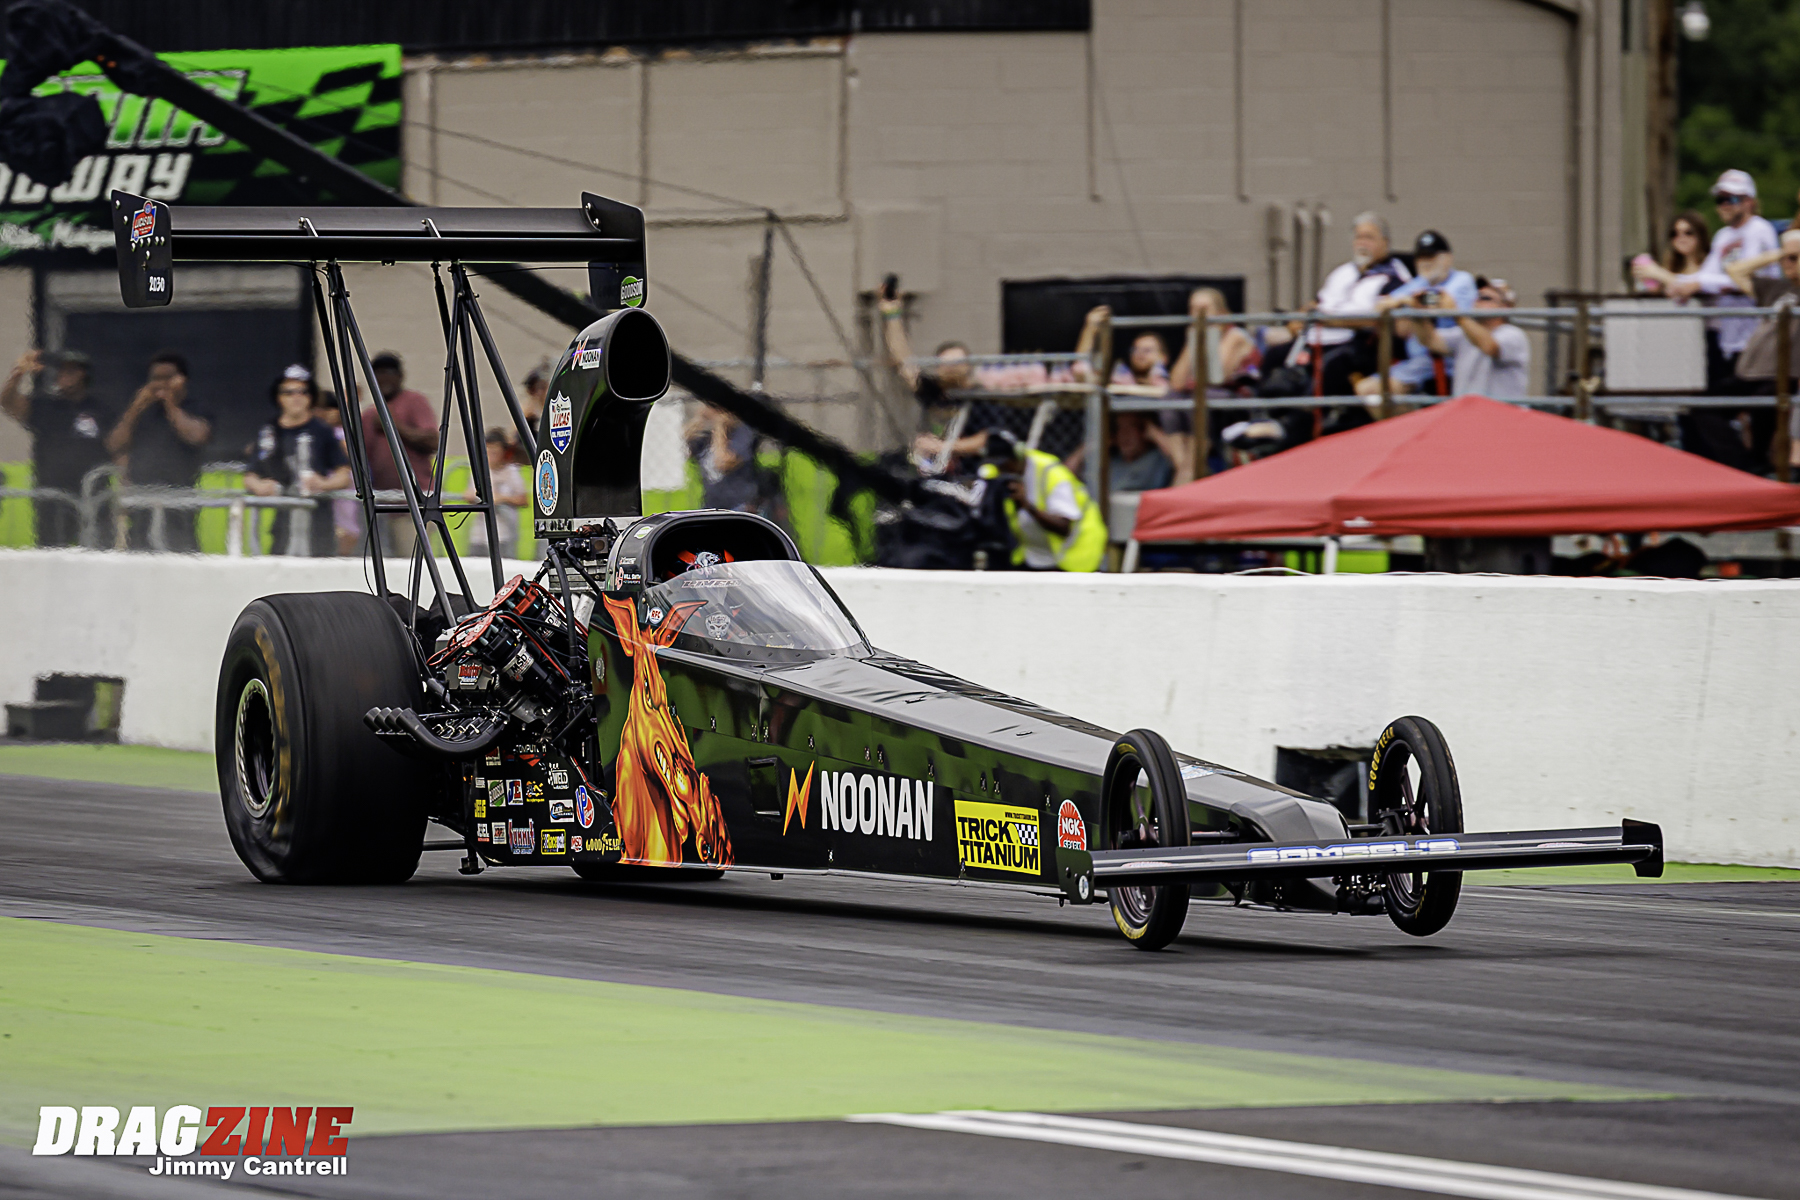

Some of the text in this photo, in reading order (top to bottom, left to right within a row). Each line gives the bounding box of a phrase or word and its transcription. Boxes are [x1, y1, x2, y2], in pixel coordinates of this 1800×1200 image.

[621, 281, 643, 301] GOODSON
[582, 350, 600, 363] NOONAN
[552, 412, 571, 427] LUCAS
[651, 609, 661, 617] RFC
[511, 651, 529, 675] MSD
[1368, 726, 1395, 791] GOODYEAR
[553, 772, 568, 785] WELD
[821, 770, 934, 841] NOONAN
[508, 818, 536, 851] SUMMIT
[957, 815, 1014, 844] TRICK
[1061, 817, 1080, 836] NGK
[586, 833, 621, 856] GOODYEAR
[959, 840, 1039, 871] TITANIUM
